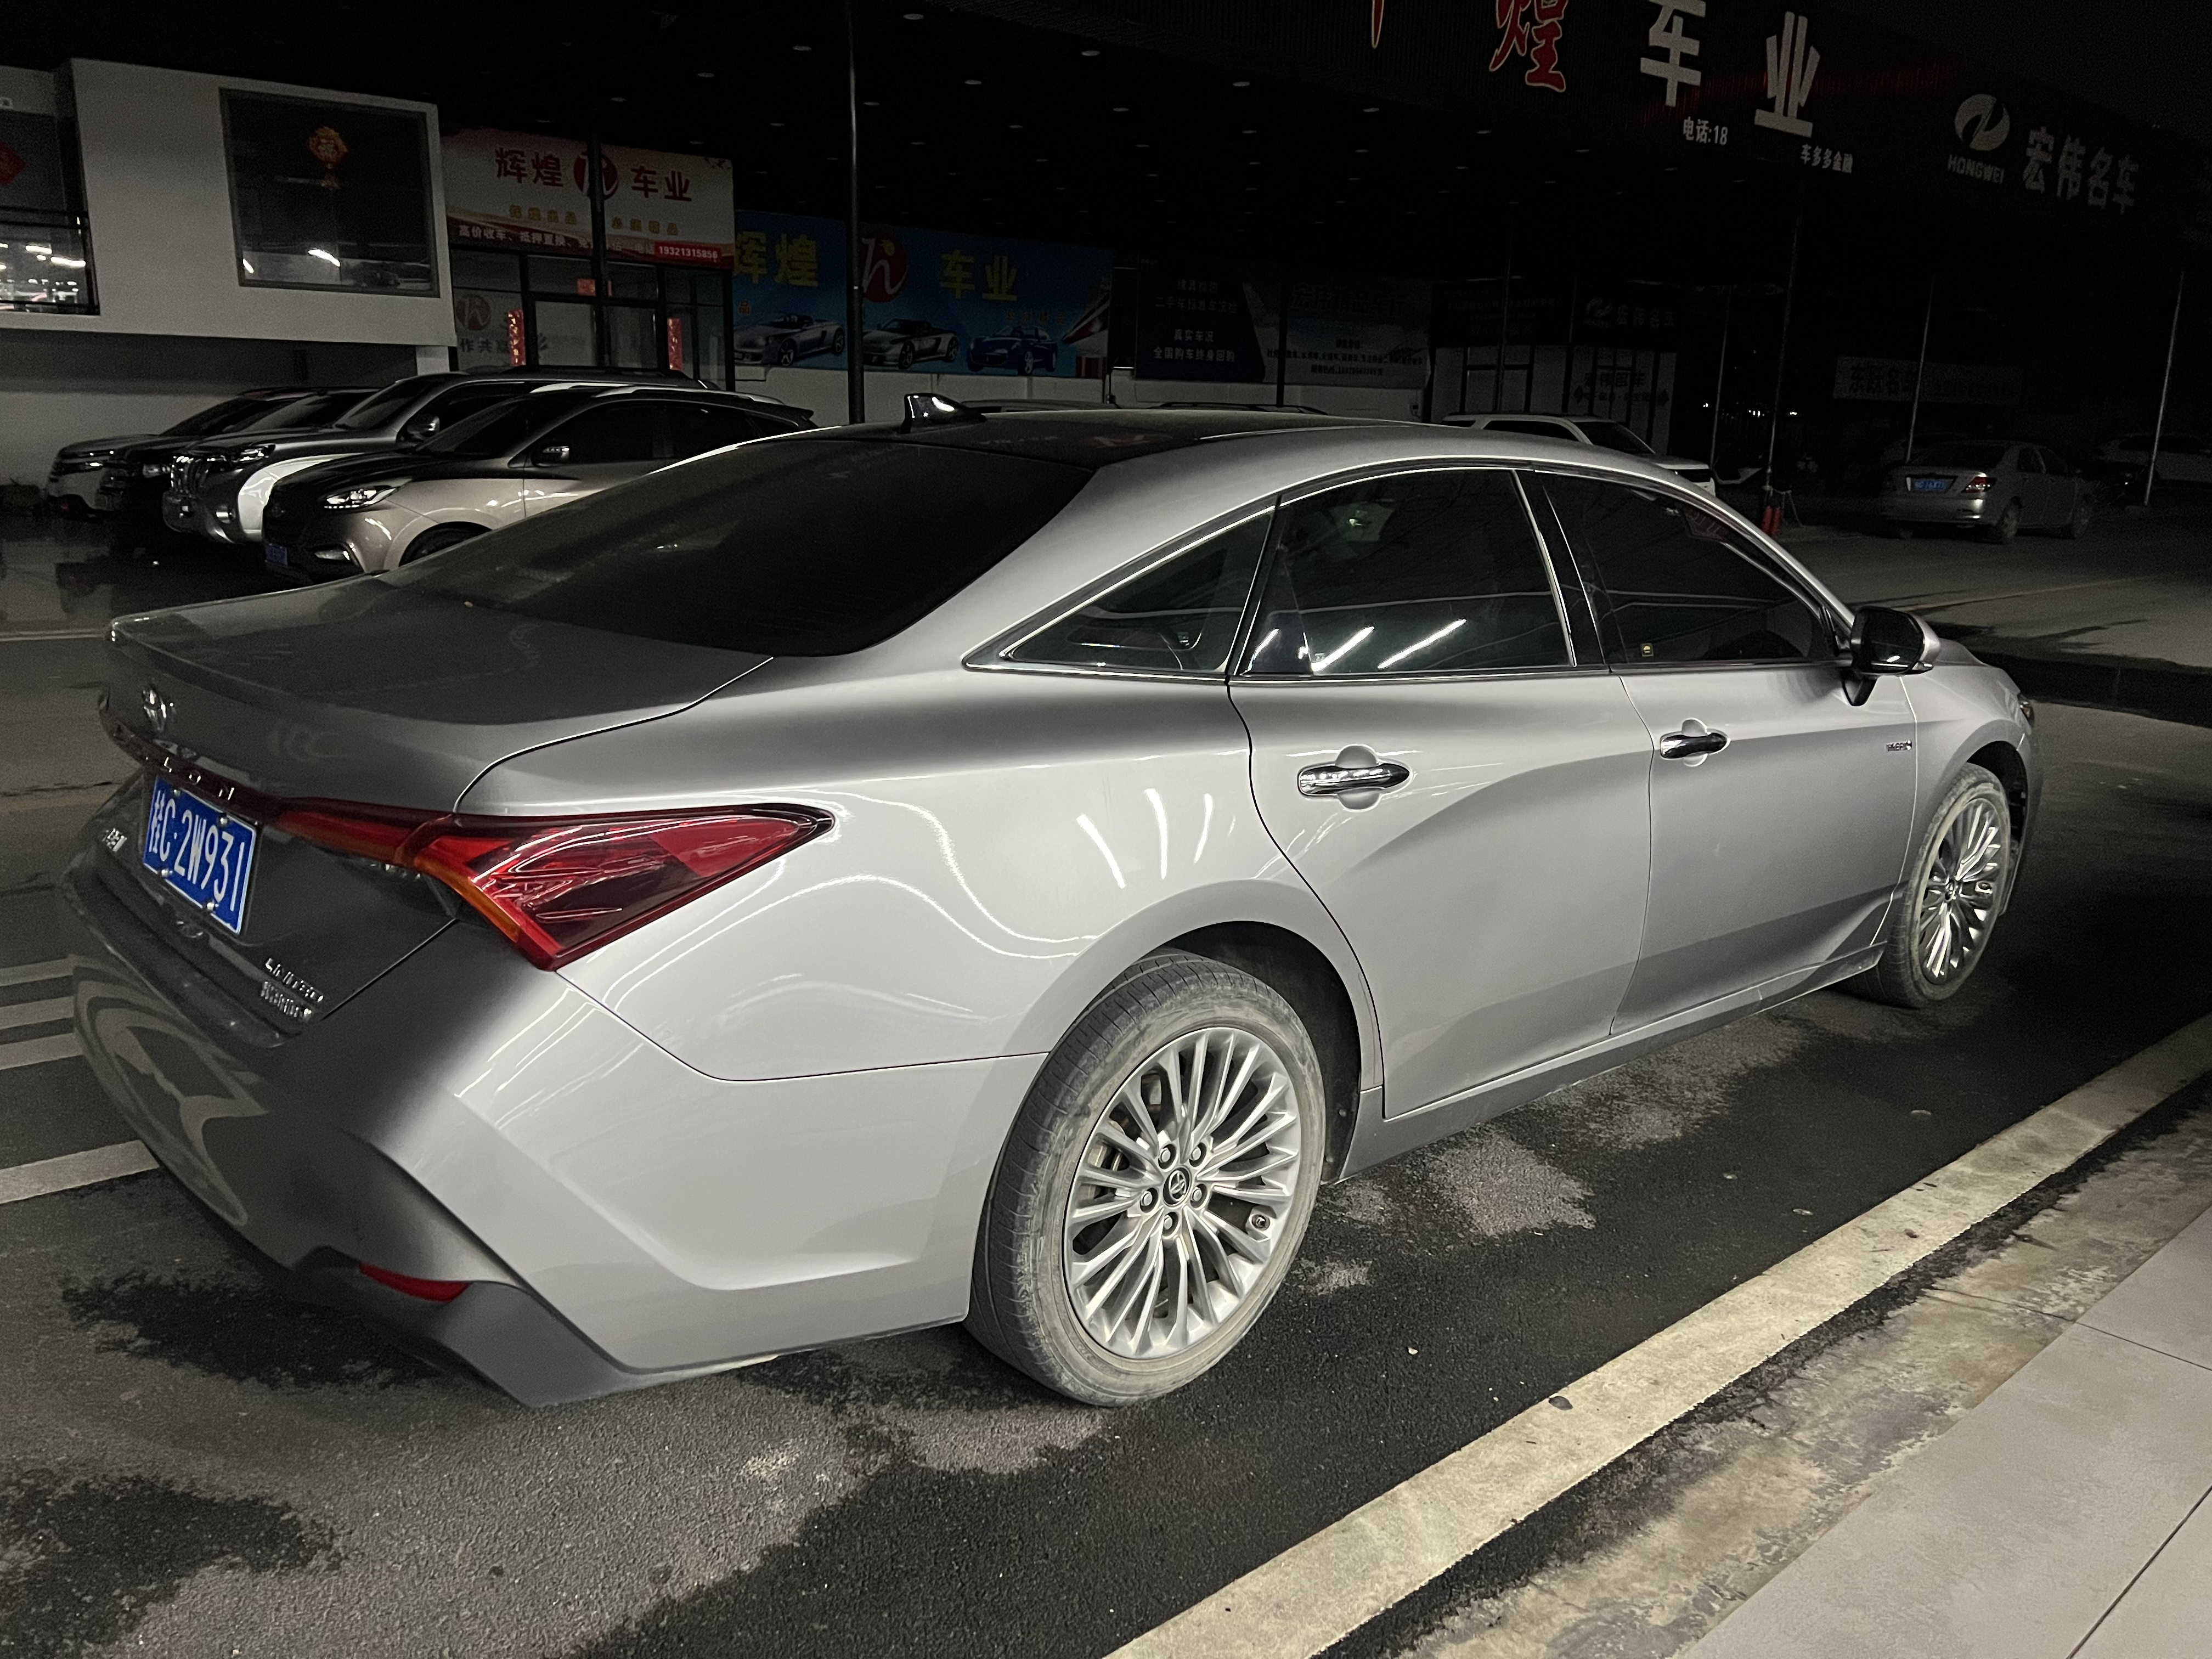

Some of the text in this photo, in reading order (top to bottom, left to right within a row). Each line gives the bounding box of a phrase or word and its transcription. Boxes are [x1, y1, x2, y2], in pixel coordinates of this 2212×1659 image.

[495, 148, 692, 201] 辉煌 车业
[1948, 154, 2005, 185] HONGWEI
[2023, 126, 2139, 215] 宏伟名车
[733, 231, 1018, 302] 辉煌 车业
